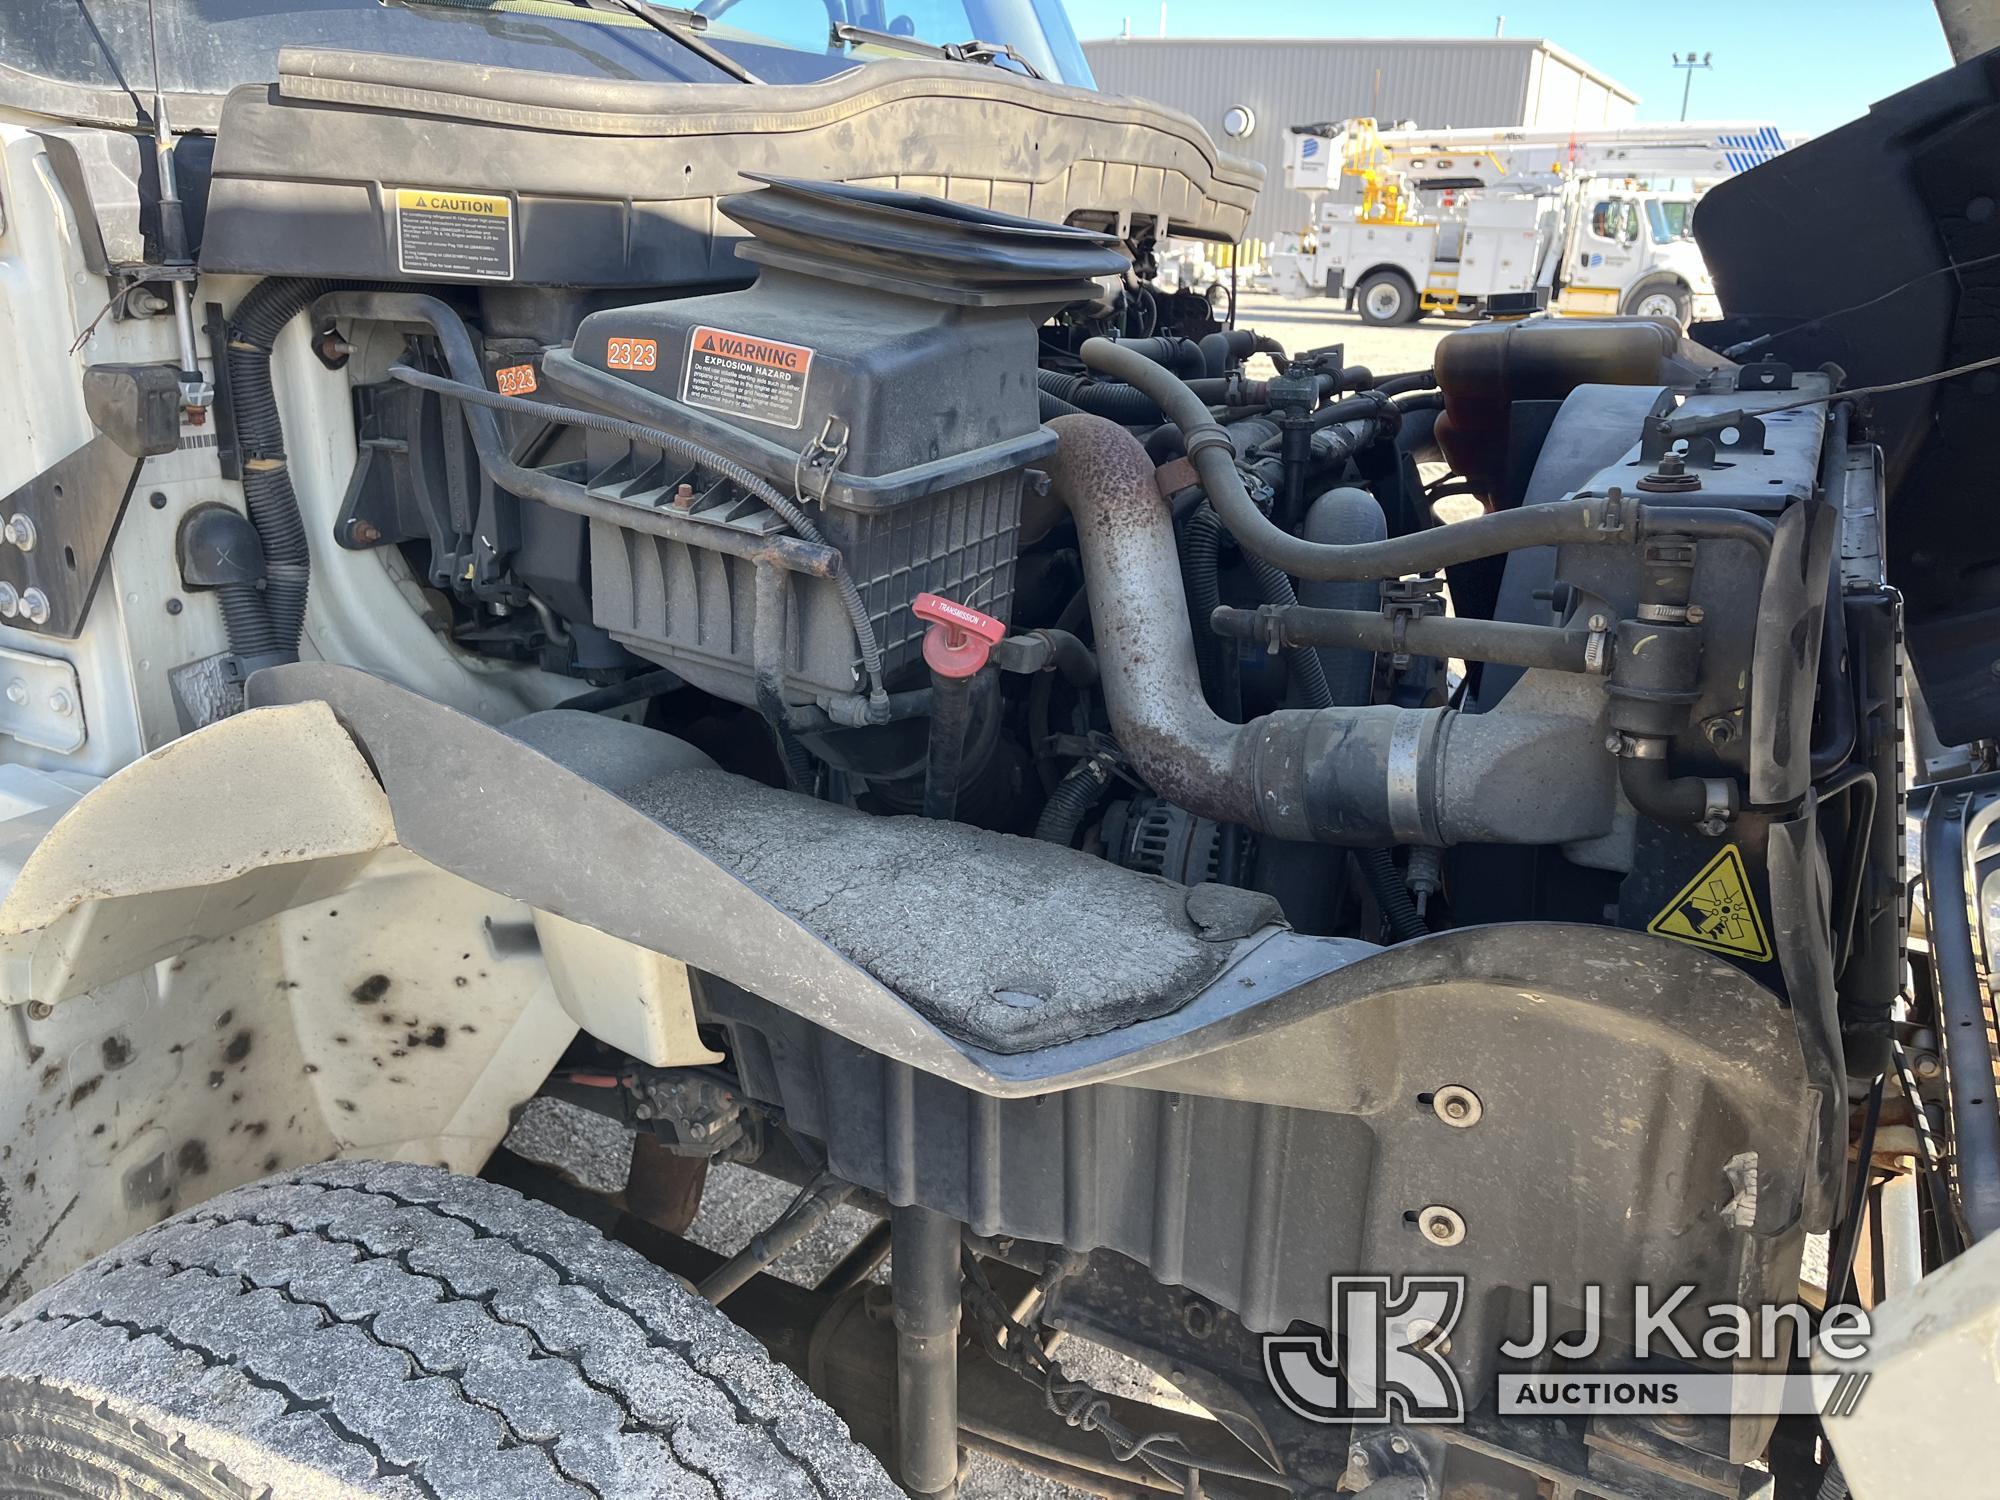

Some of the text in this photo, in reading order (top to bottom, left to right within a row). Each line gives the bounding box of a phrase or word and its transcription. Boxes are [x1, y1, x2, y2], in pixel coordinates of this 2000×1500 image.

[430, 198, 493, 213] CAUTION
[720, 338, 797, 368] WARNING
[704, 356, 792, 381] EXPLOSION HAZARD
[940, 603, 980, 624] TRANSMISSION
